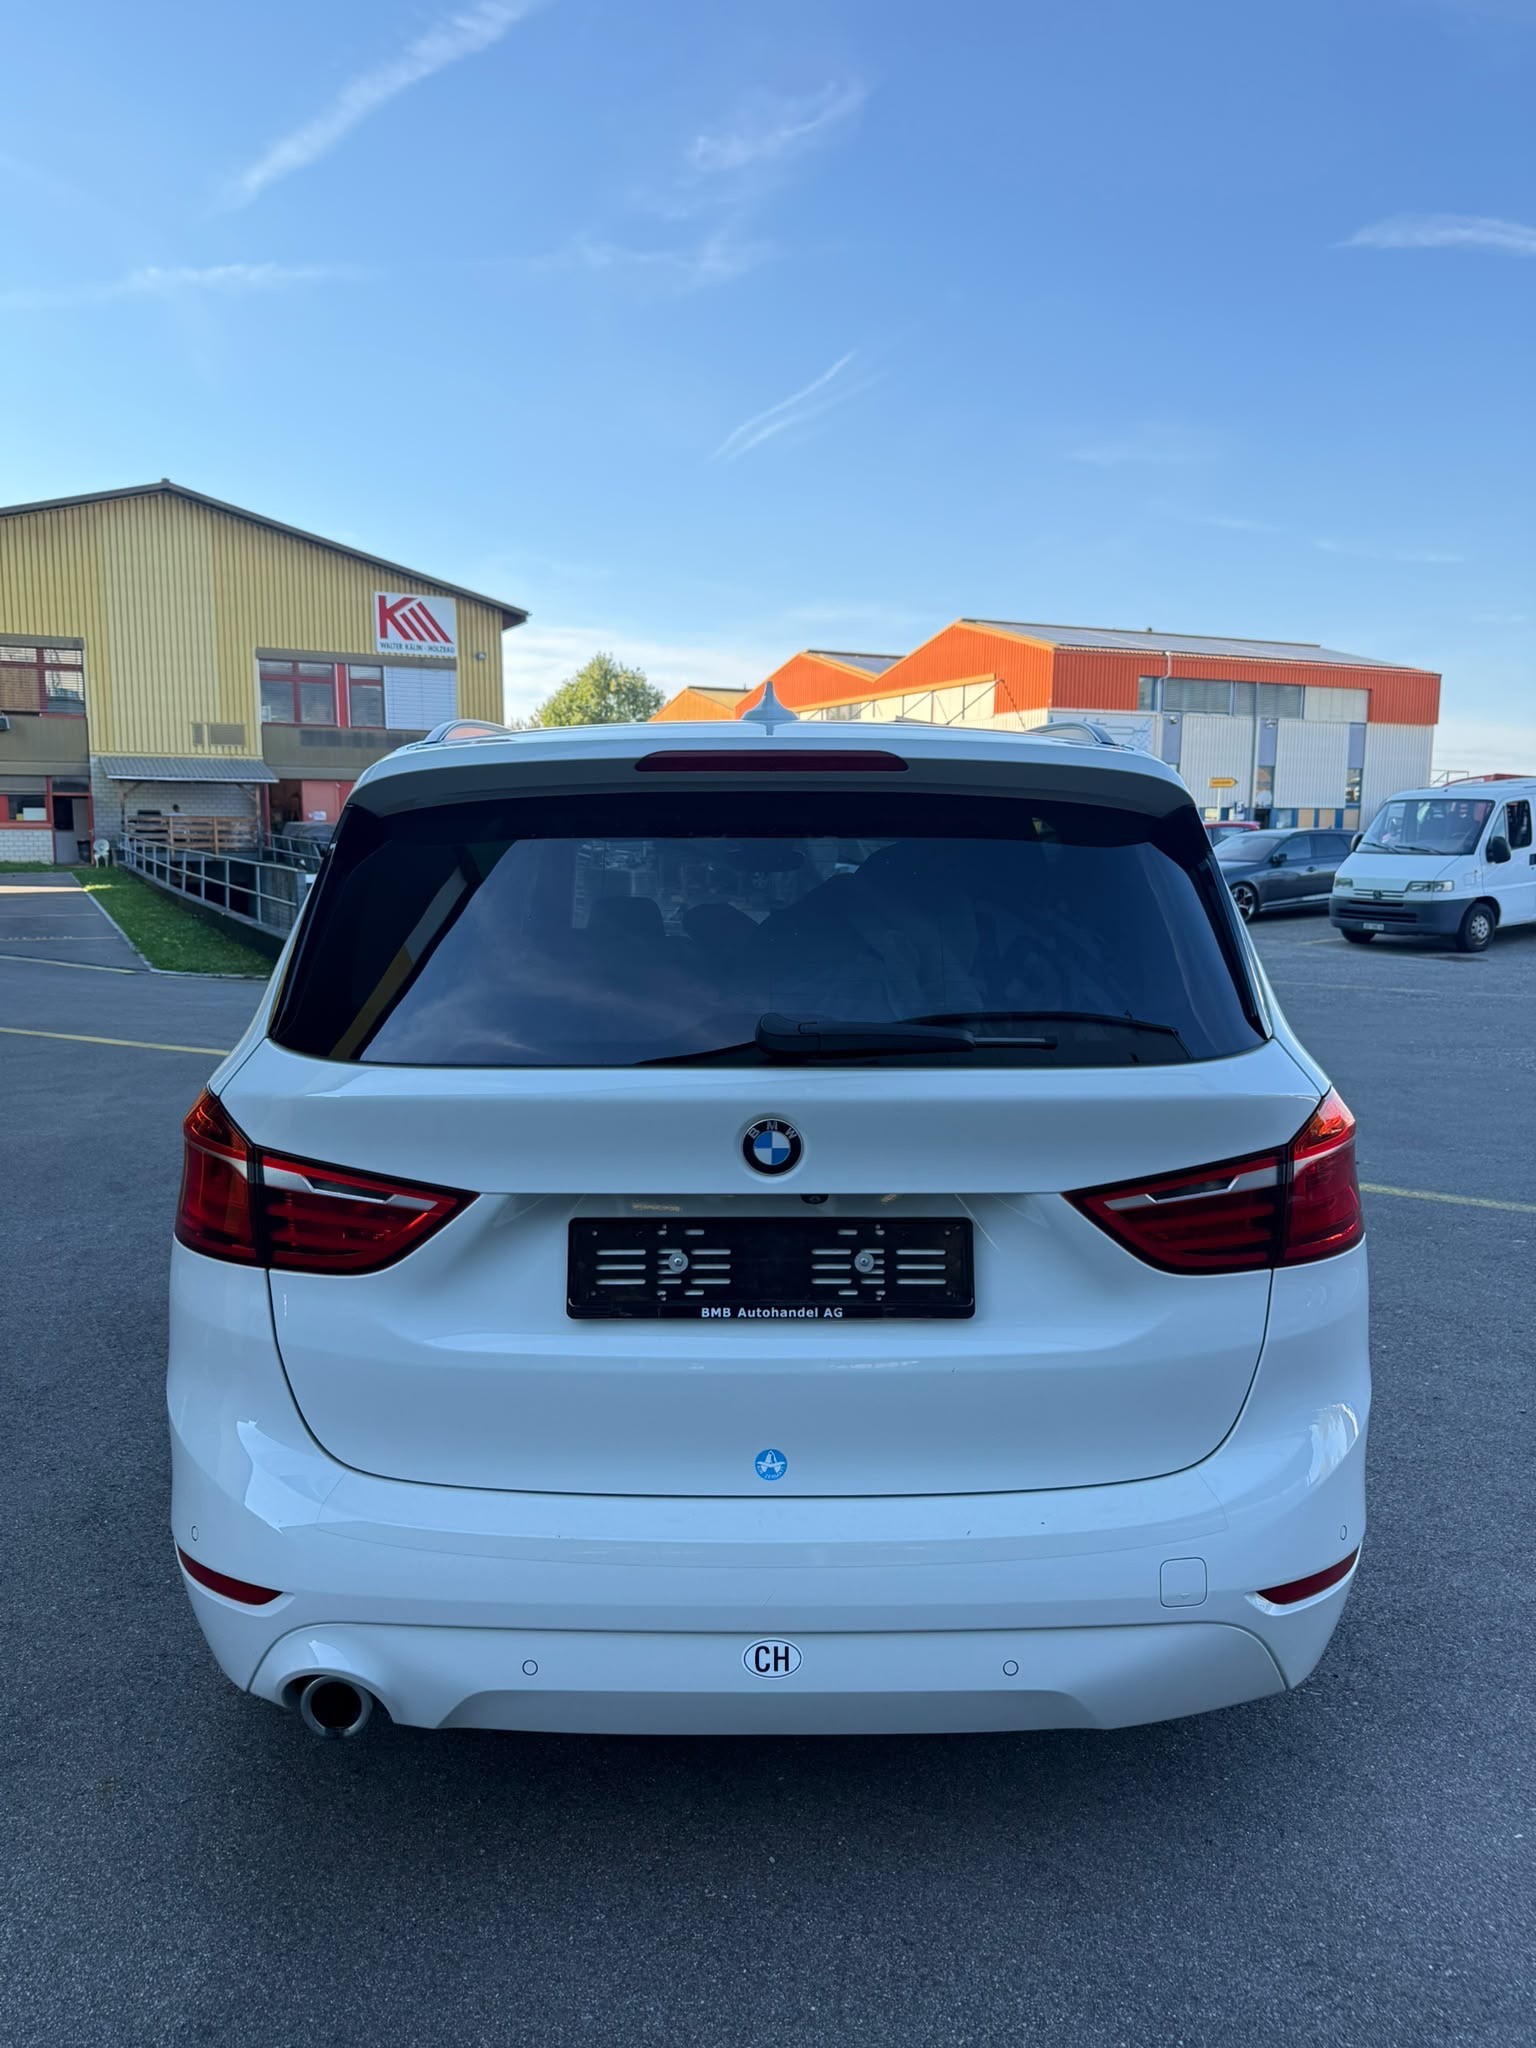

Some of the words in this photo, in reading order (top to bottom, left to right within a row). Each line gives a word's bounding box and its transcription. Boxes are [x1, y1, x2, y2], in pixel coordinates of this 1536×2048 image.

[379, 642, 403, 650] WALTER
[748, 1121, 798, 1139] BMW
[701, 1307, 731, 1318] BMB
[737, 1307, 819, 1318] Autohandel
[823, 1307, 843, 1318] AG
[754, 1645, 790, 1673] CH
